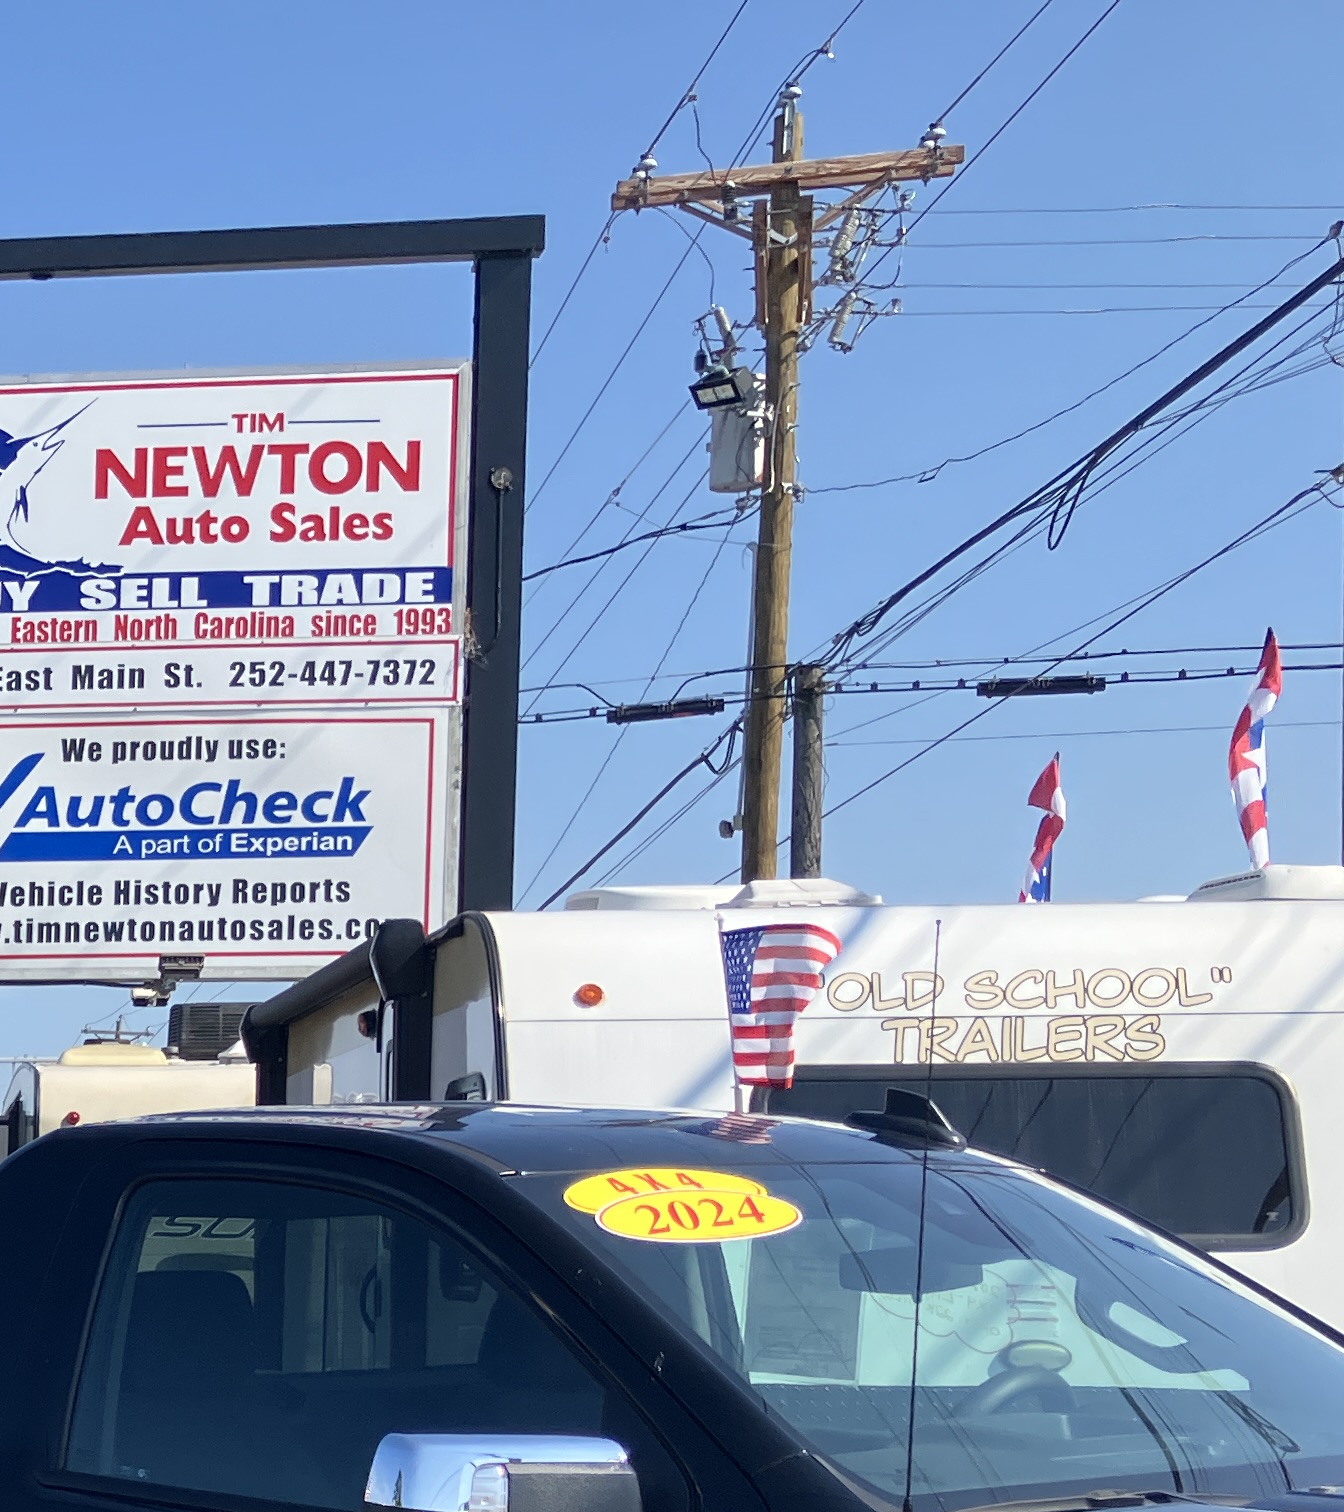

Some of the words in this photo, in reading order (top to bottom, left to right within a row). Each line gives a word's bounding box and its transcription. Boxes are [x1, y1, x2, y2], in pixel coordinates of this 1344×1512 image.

[232, 413, 285, 434] TIM
[94, 441, 421, 499] NEWTON
[119, 506, 250, 546] Auto
[270, 503, 394, 543] Sales
[80, 577, 207, 610] SELL
[243, 572, 434, 606] TRADE
[12, 617, 98, 644] Eastern
[114, 613, 177, 642] North
[194, 611, 295, 640] Carolina
[312, 610, 376, 637] since
[394, 608, 451, 635] 1993
[72, 664, 145, 690] Main
[164, 662, 202, 689] St.
[229, 659, 436, 687] 252-447-7372
[61, 738, 102, 762] We
[112, 736, 219, 764] proudly
[228, 736, 286, 760] use:
[13, 777, 372, 828] AutoCheck
[112, 835, 133, 855] A
[140, 835, 190, 859] part
[197, 833, 223, 854] of
[231, 832, 353, 857] Experian
[114, 879, 221, 907] History
[233, 878, 351, 905] Reports
[965, 967, 1232, 1009] SCHOOL"
[882, 1015, 1166, 1063] TRAILERS
[635, 1196, 765, 1235] 2024
